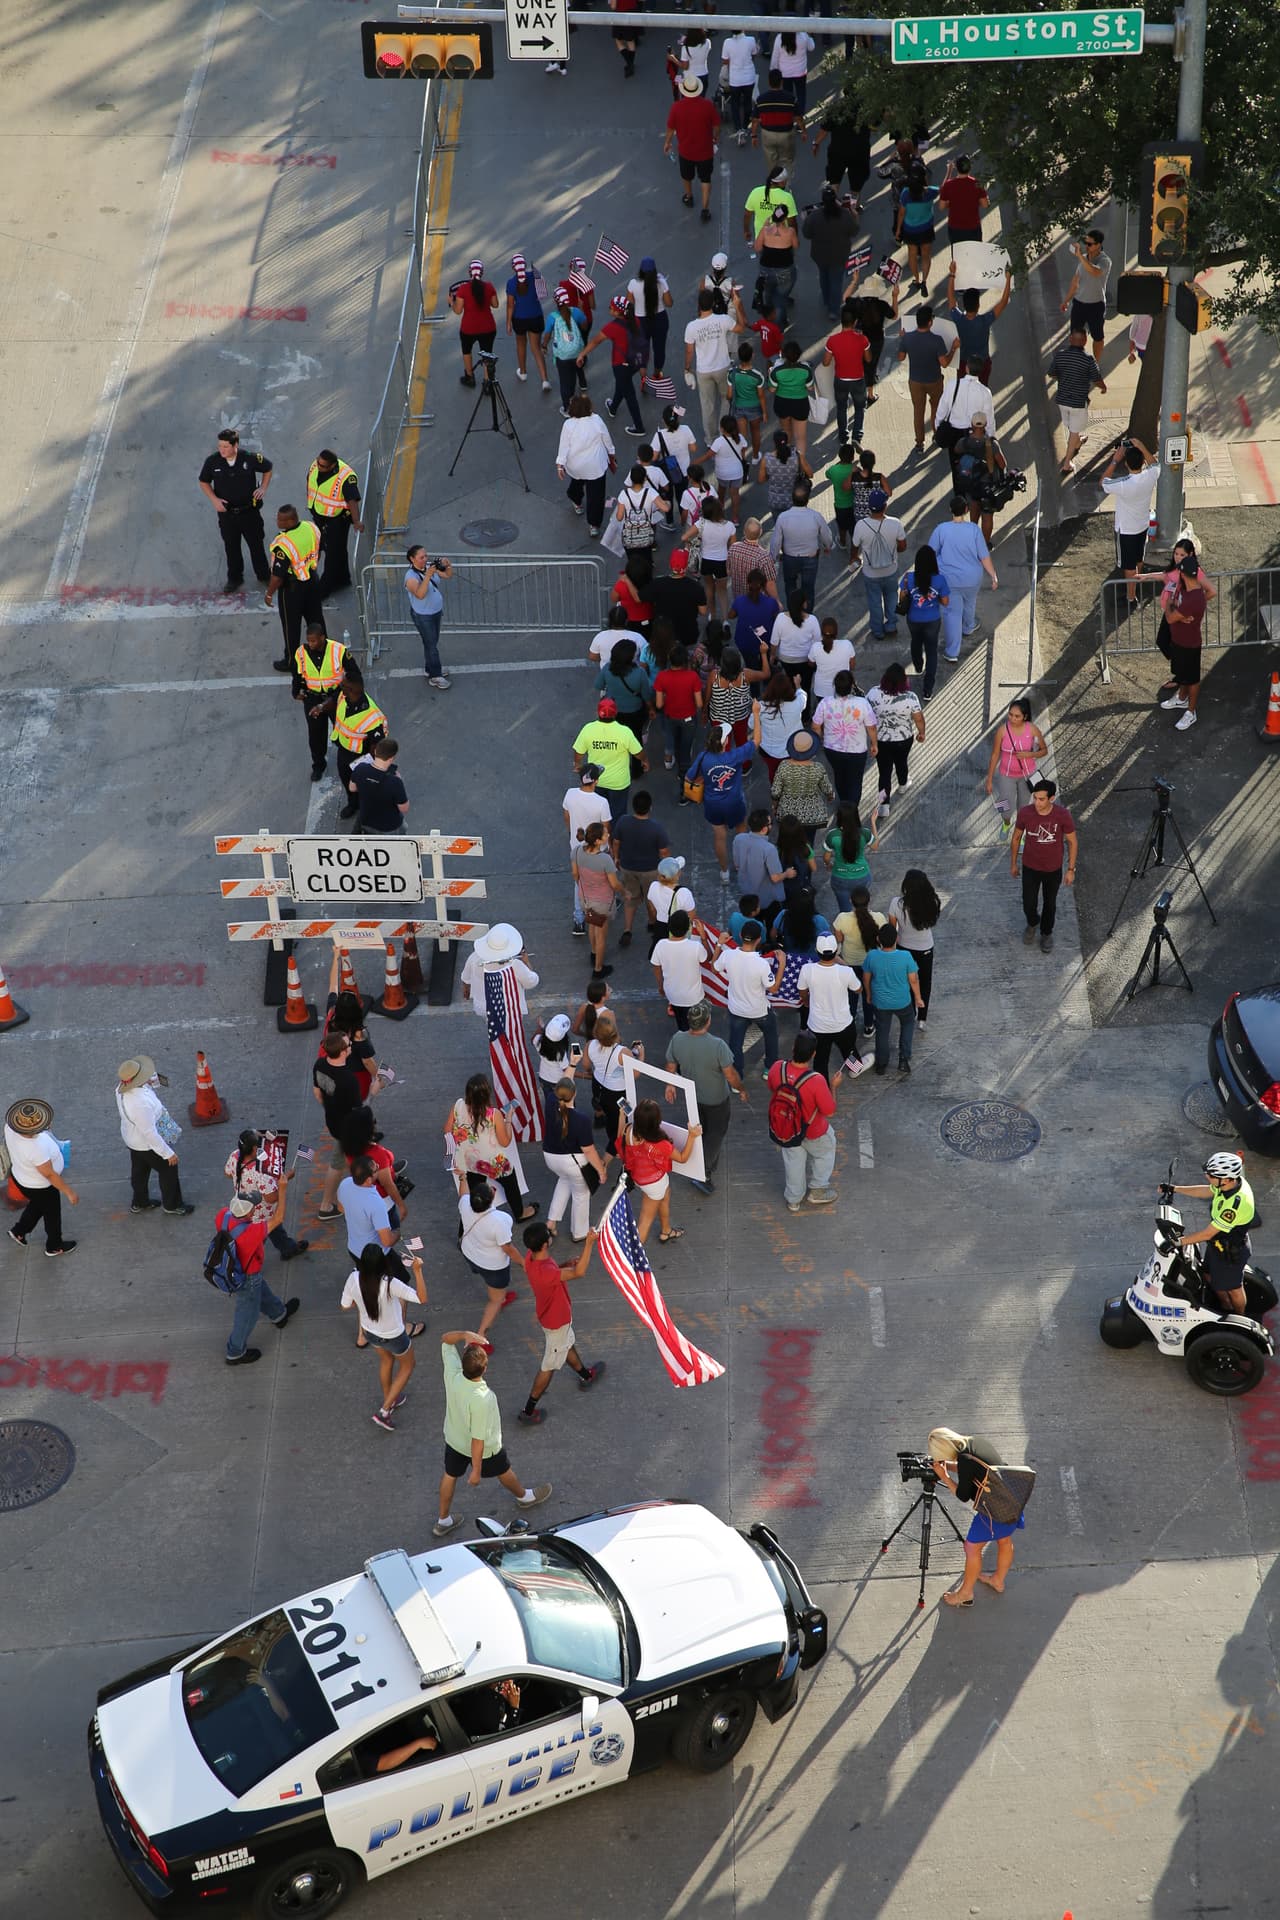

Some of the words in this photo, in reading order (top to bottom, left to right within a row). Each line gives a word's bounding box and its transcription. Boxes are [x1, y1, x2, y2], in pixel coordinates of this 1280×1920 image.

[515, 13, 557, 28] WAY
[899, 23, 929, 45] N.
[940, 19, 1077, 43] Houston
[1092, 15, 1136, 36] St.
[925, 47, 959, 57] 2600
[1077, 41, 1110, 51] 2700
[592, 741, 618, 750] SECURITY
[317, 848, 391, 867] ROAD
[307, 874, 407, 893] CLOSED
[338, 930, 375, 938] Bernie
[1129, 1290, 1186, 1318] POLICE
[287, 1597, 376, 1712] 2011
[635, 1695, 678, 1720] 2011
[507, 1721, 603, 1767] DALLAS
[366, 1749, 581, 1853] POLICE
[191, 1856, 256, 1881] COMMANDER
[194, 1847, 248, 1872] WATCH
